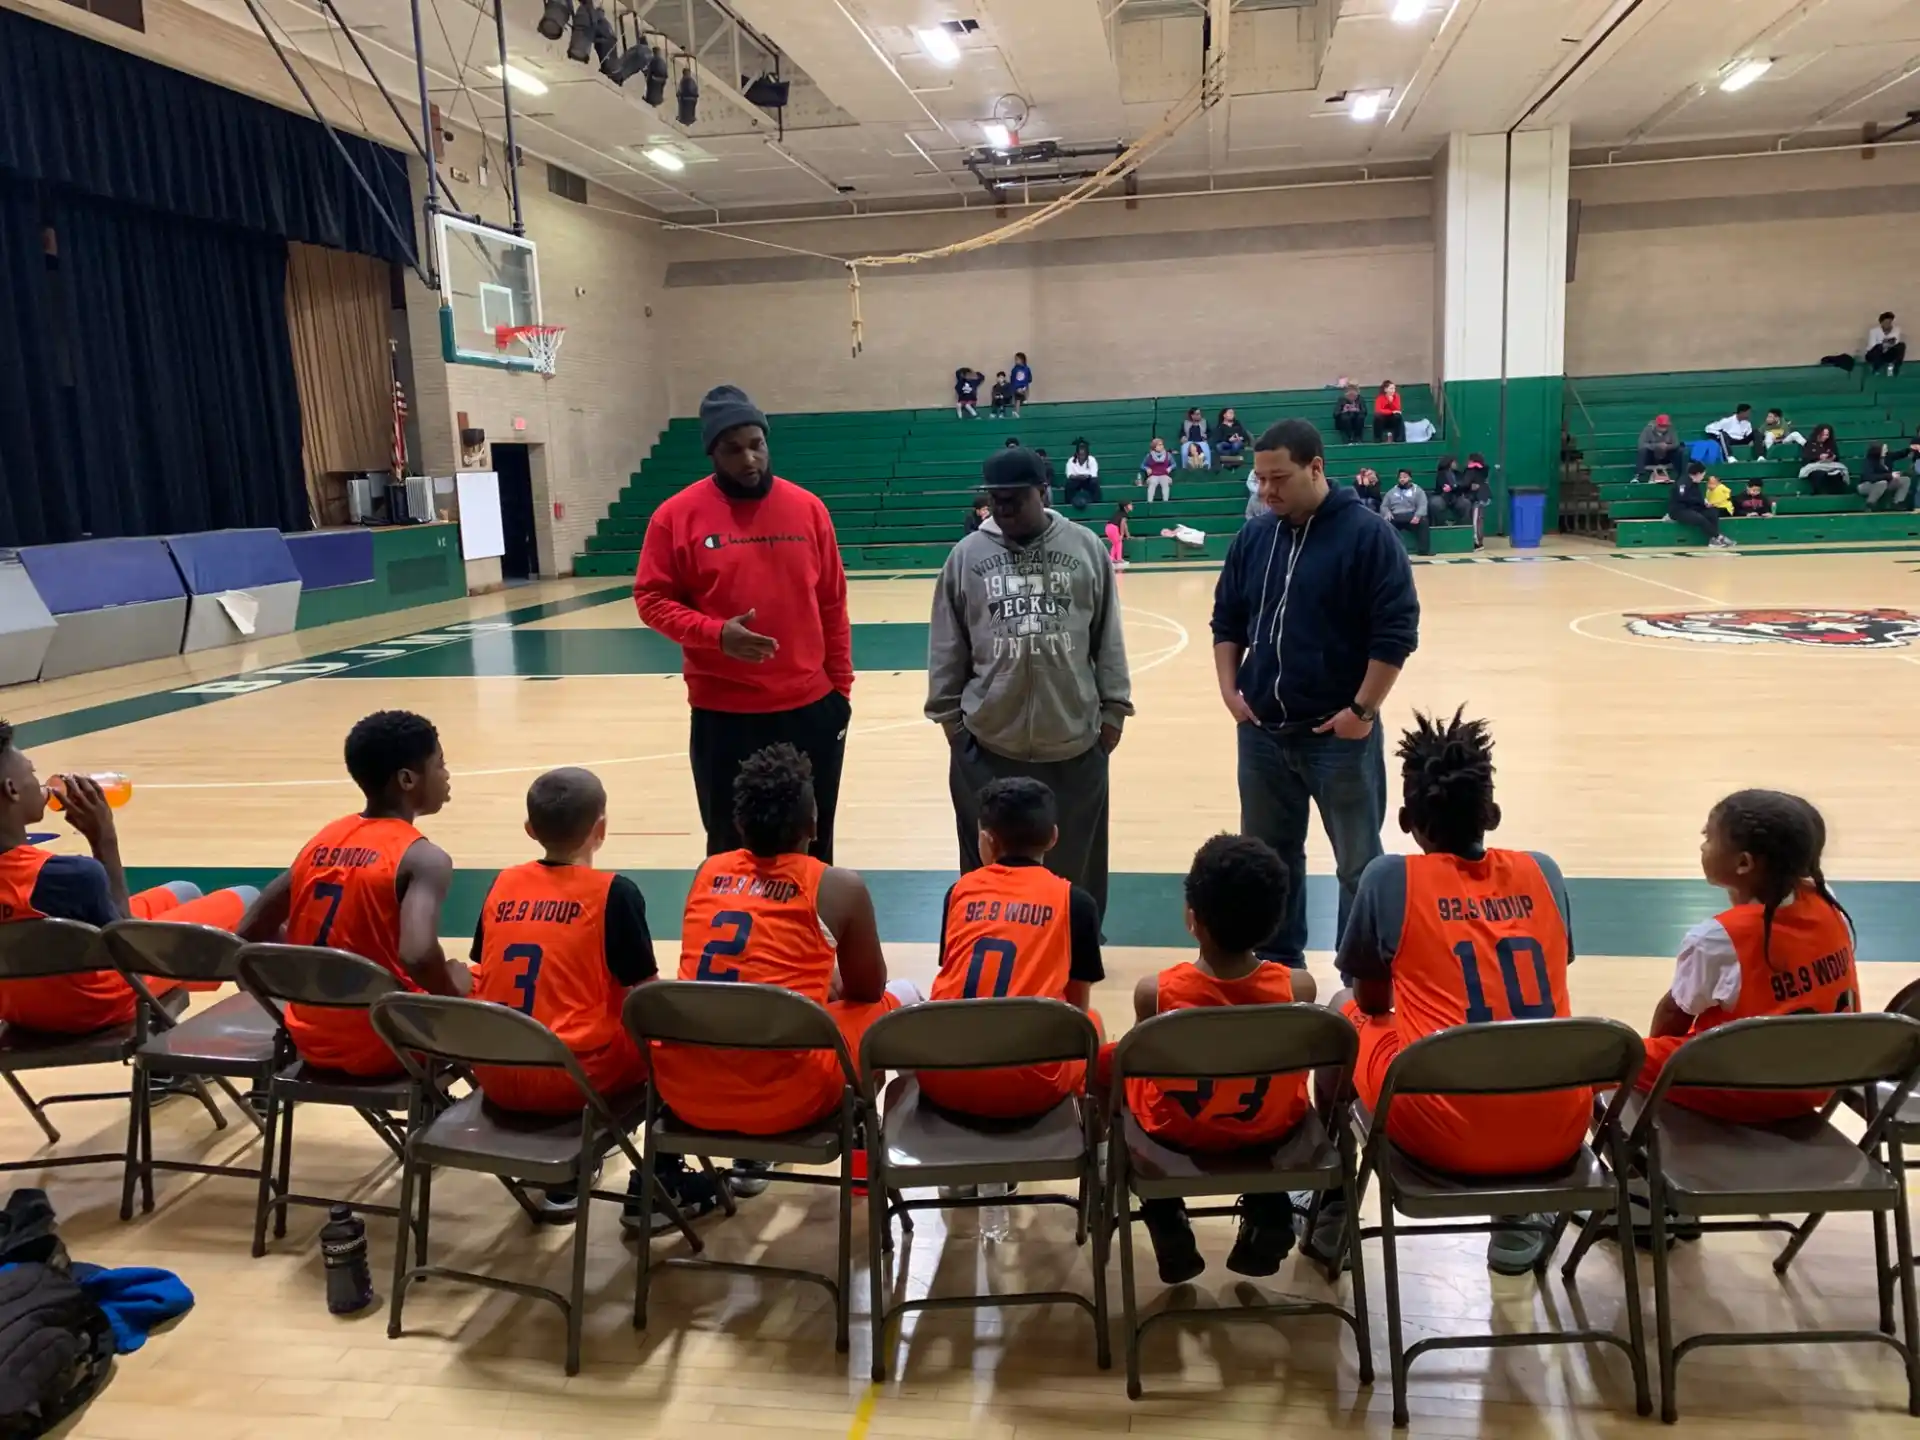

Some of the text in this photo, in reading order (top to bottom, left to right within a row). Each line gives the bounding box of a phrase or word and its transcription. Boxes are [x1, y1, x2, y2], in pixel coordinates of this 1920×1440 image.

[703, 532, 808, 550] Champion
[983, 575, 1004, 599] 19
[313, 881, 344, 947] 7
[495, 899, 582, 925] 92.9 WDUP
[965, 900, 1053, 928] 92.9 WDUP
[1437, 895, 1534, 922] 92.9 WDUP
[695, 909, 754, 982] 2
[497, 943, 544, 1016] 3
[1453, 936, 1557, 1024] 10
[1770, 964, 1813, 1003] 92.9
